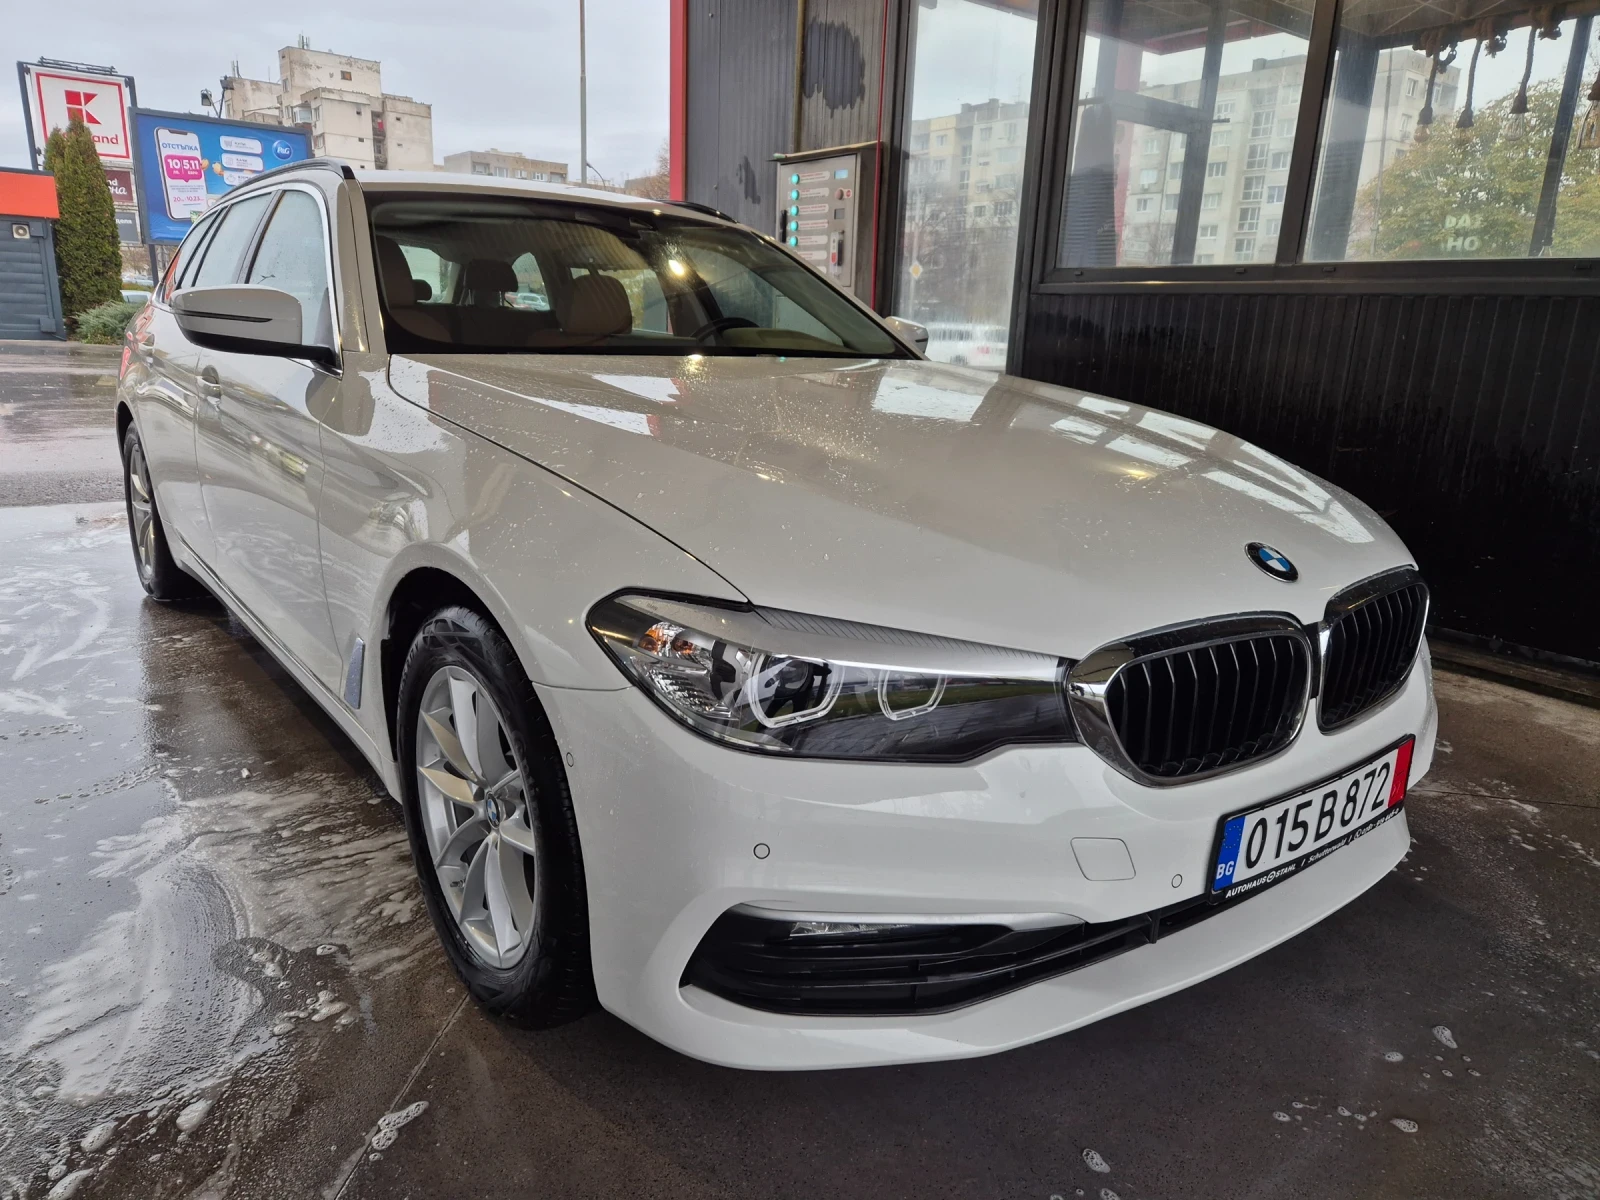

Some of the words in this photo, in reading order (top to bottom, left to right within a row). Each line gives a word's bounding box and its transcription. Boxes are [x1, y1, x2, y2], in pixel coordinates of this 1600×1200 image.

[161, 142, 199, 152] ОТСТЪПКА
[167, 158, 181, 169] 10
[1216, 860, 1235, 880] BG
